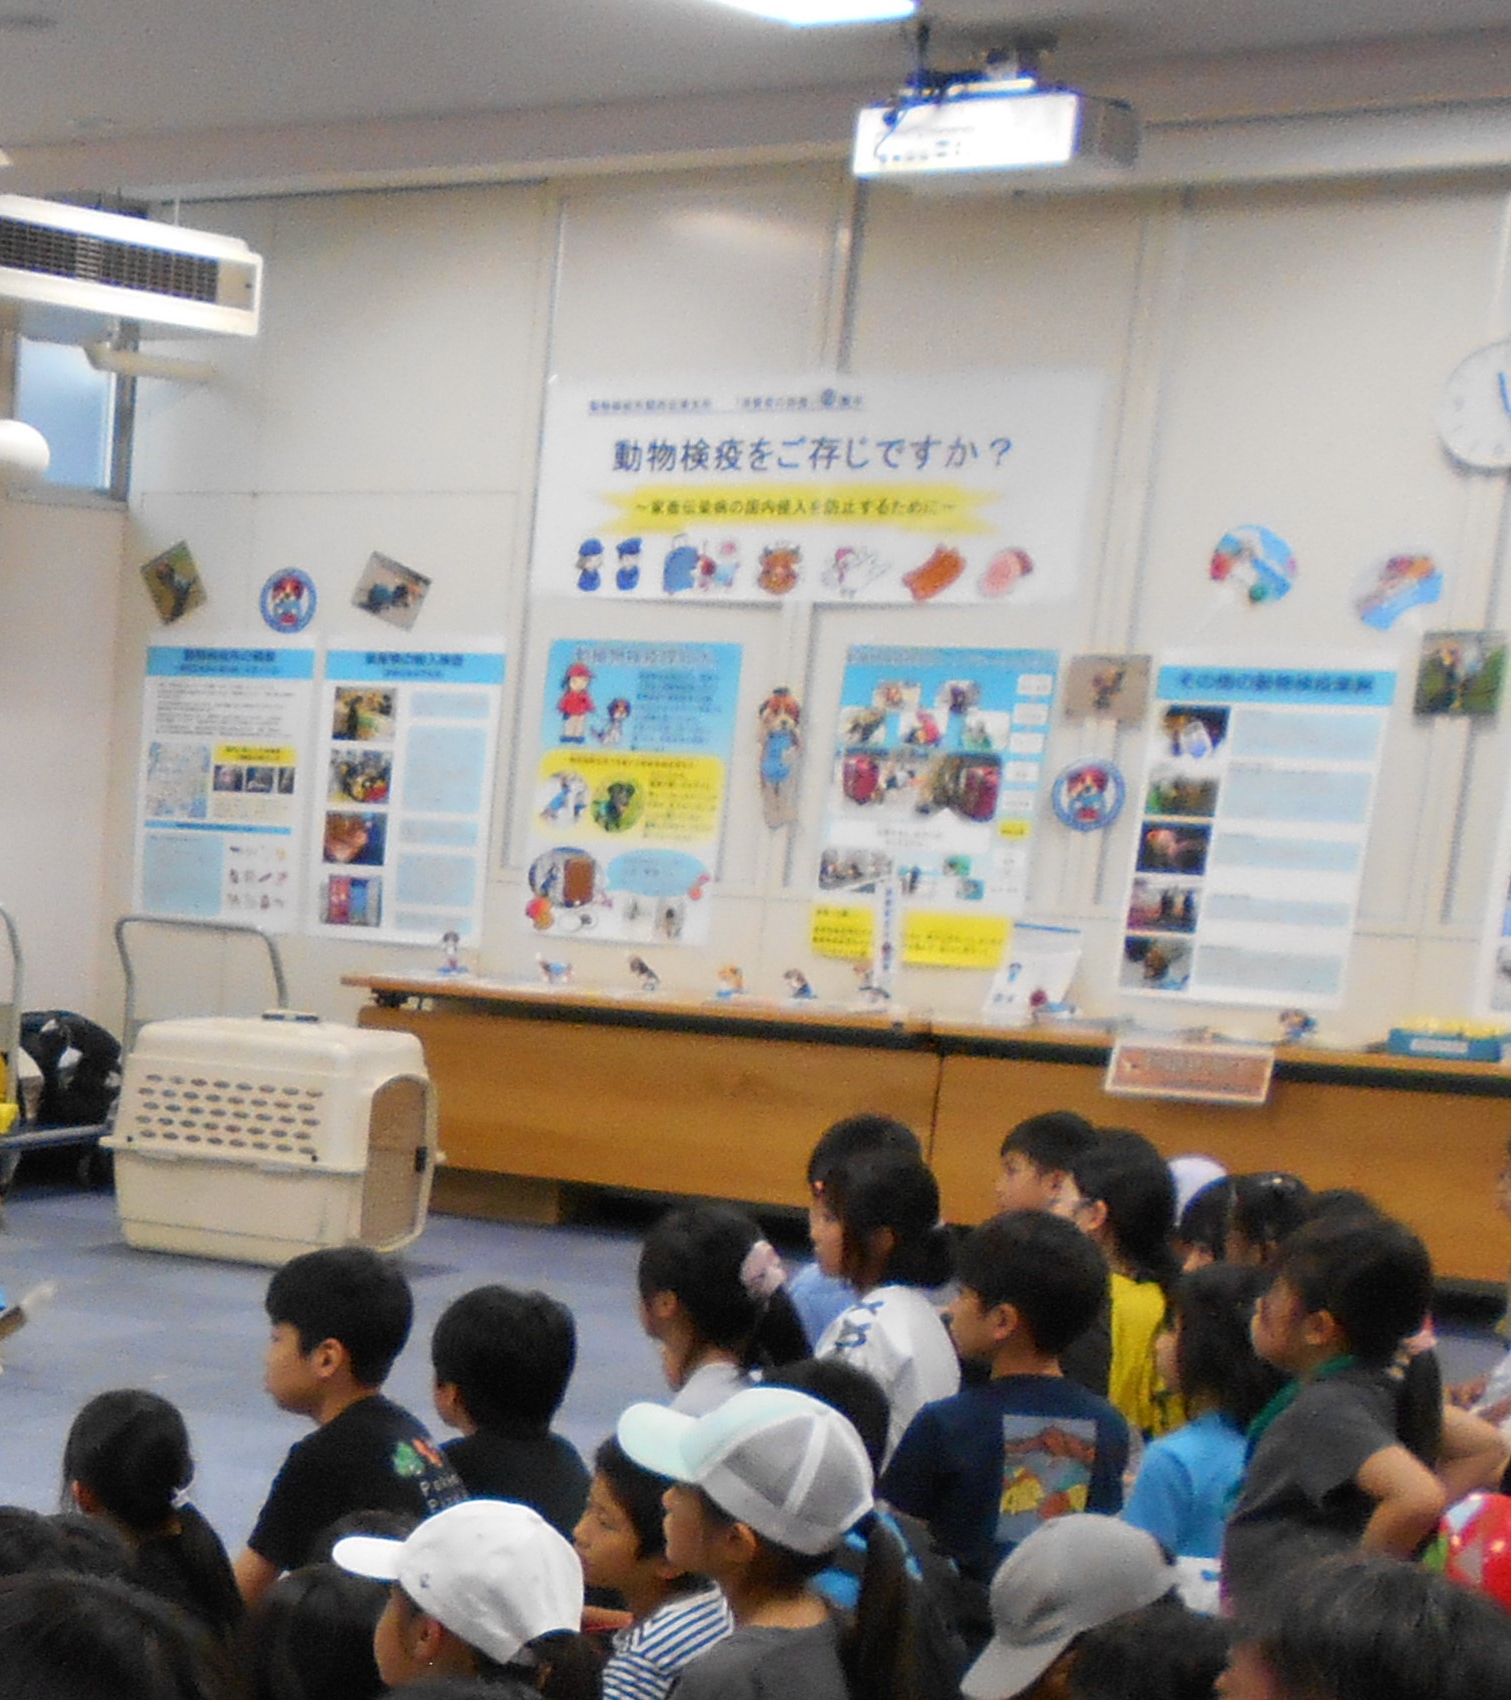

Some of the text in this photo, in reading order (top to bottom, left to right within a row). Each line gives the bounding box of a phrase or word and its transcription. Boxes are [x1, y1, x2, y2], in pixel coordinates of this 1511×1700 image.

[613, 437, 1013, 473] 動物検疫をご存じですか？
